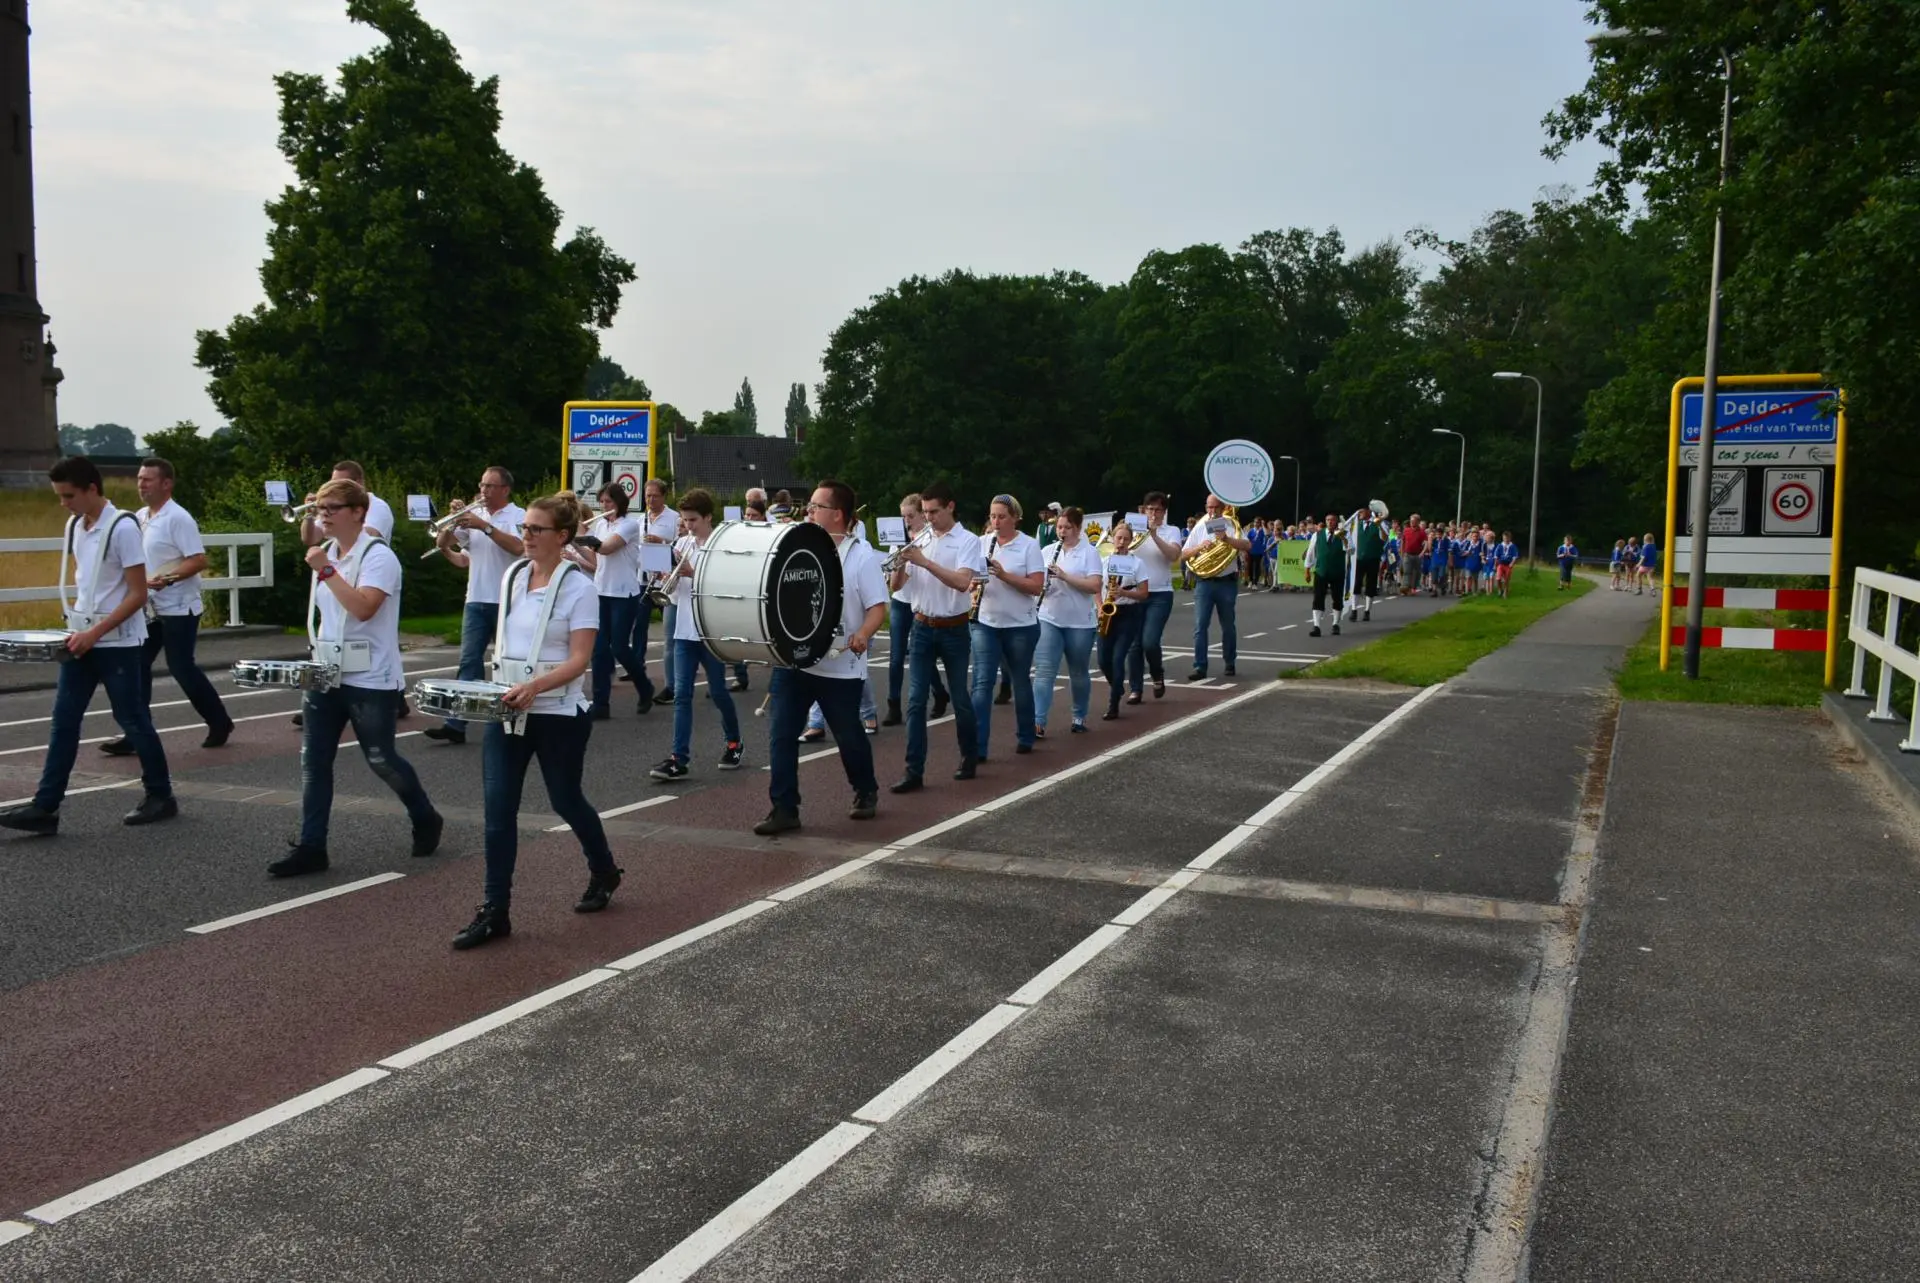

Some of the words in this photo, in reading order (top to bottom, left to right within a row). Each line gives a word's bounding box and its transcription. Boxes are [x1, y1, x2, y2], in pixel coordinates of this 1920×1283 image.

[1724, 400, 1793, 415] Delden
[1745, 423, 1763, 433] Hof
[1767, 424, 1787, 433] van
[1789, 422, 1831, 432] Twente
[1215, 457, 1260, 465] AMICITIA
[1717, 449, 1739, 460] tot
[1742, 449, 1780, 463] ziens
[1711, 472, 1730, 480] ONE
[1781, 472, 1807, 480] ZONE
[1779, 495, 1806, 509] 60
[784, 570, 818, 582] AMICITIA
